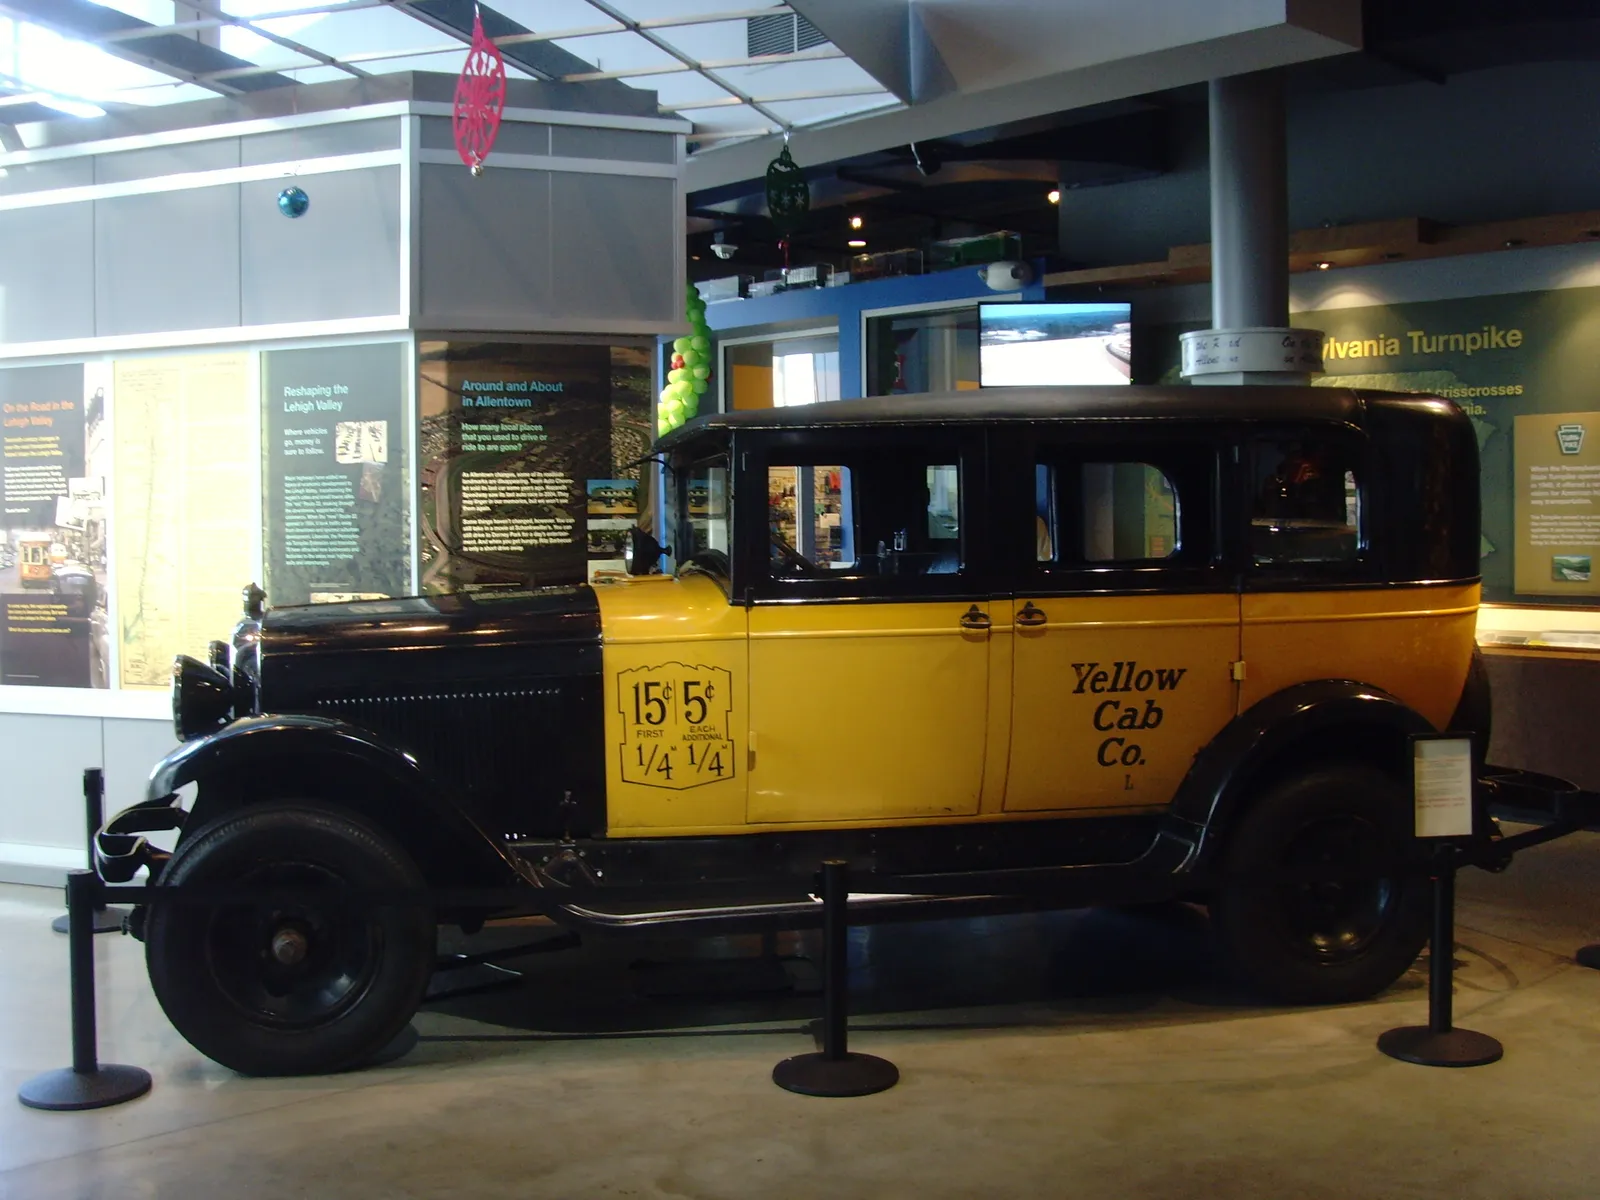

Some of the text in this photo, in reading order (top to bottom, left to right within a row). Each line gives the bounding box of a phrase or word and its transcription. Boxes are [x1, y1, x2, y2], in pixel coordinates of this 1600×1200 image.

[1407, 326, 1522, 356] Turnpike
[284, 384, 348, 398] Reshaping the
[462, 380, 563, 392] Around and About
[1436, 385, 1523, 398] crisscrosses
[284, 400, 342, 414] Lehigh Valley
[462, 396, 532, 407] in Allentown
[480, 424, 500, 432] many
[1071, 662, 1188, 694] Yellow
[632, 681, 672, 725] 15¢
[684, 680, 714, 724] 5¢
[1093, 700, 1164, 731] Cab
[636, 730, 664, 738] FIRST
[682, 733, 722, 741] ADDITIONAL
[1097, 737, 1146, 767] Co.
